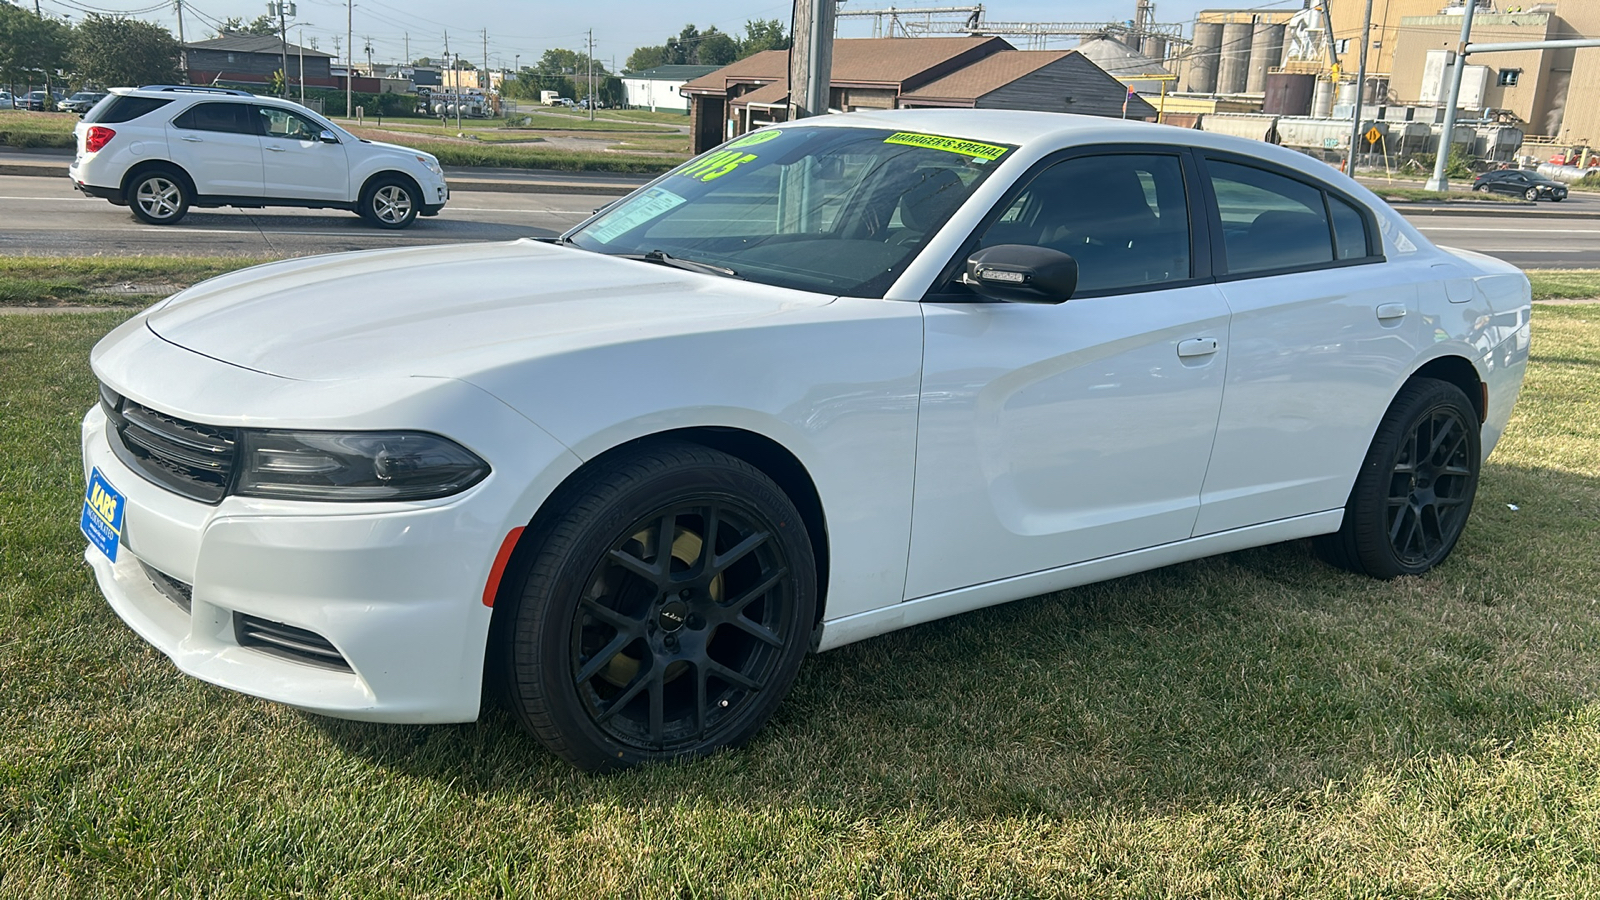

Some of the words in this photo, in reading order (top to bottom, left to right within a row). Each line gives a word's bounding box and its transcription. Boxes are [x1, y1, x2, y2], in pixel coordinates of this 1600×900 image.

[889, 133, 956, 149] MANAGER'S
[952, 140, 1004, 157] SPECIAL
[91, 481, 117, 522] KARS
[86, 506, 114, 540] INCORPORATED
